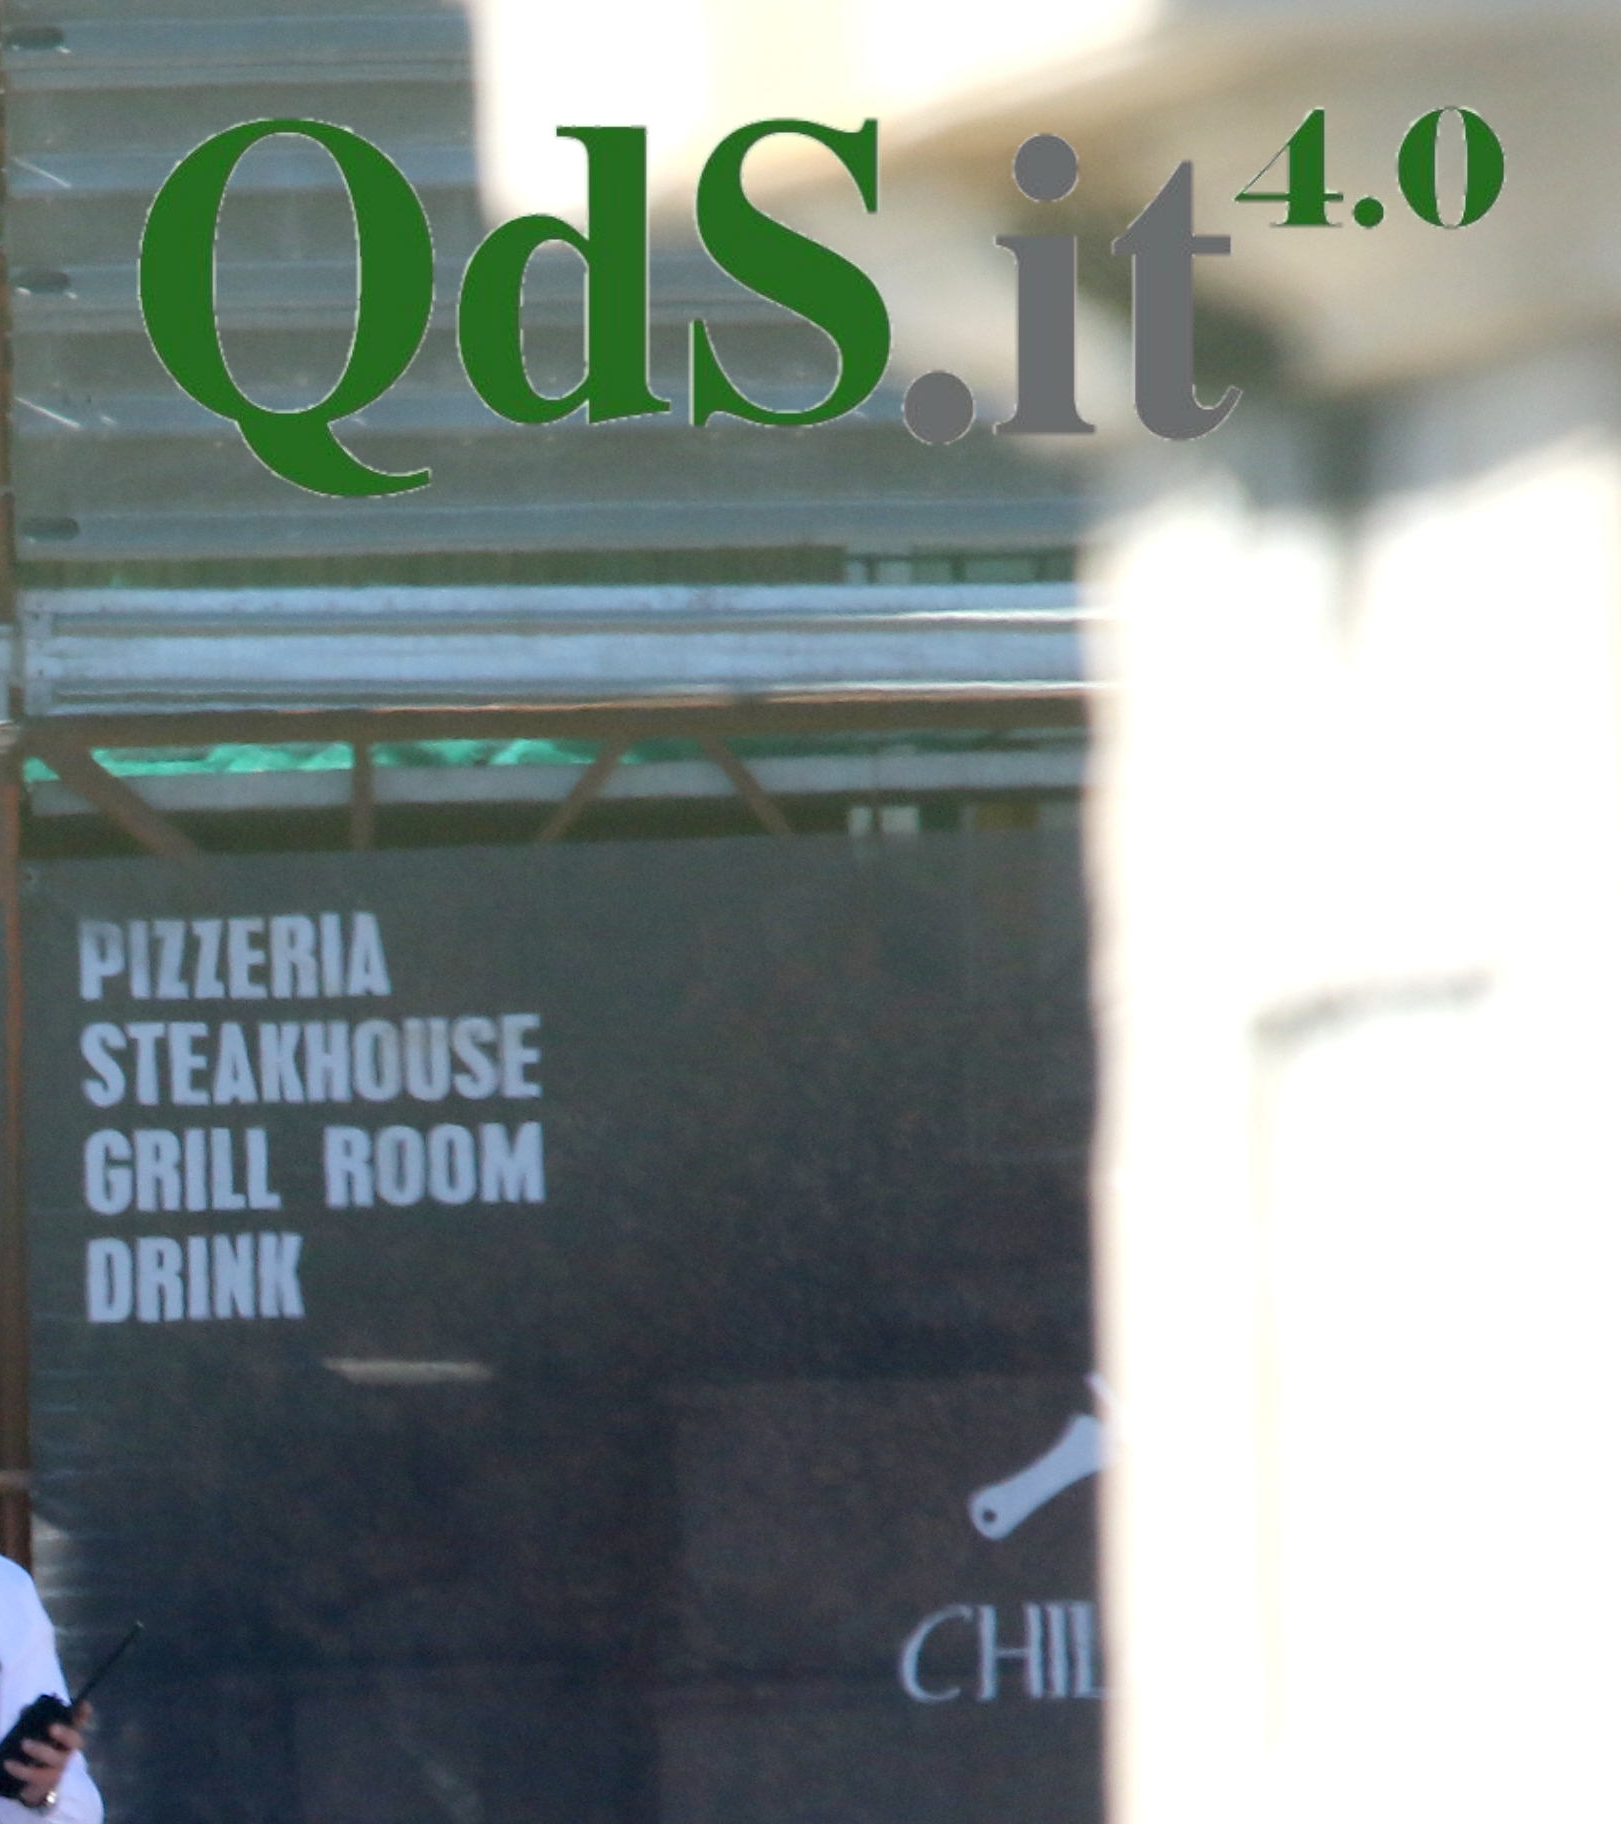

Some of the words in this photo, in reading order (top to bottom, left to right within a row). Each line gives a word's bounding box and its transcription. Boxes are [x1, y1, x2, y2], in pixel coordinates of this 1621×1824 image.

[78, 910, 391, 1001] PIZZERIA
[79, 1013, 542, 1108] STEAKHOUSE
[83, 1128, 281, 1215] GRILL
[322, 1121, 546, 1208] ROOM
[85, 1232, 305, 1324] DRINK
